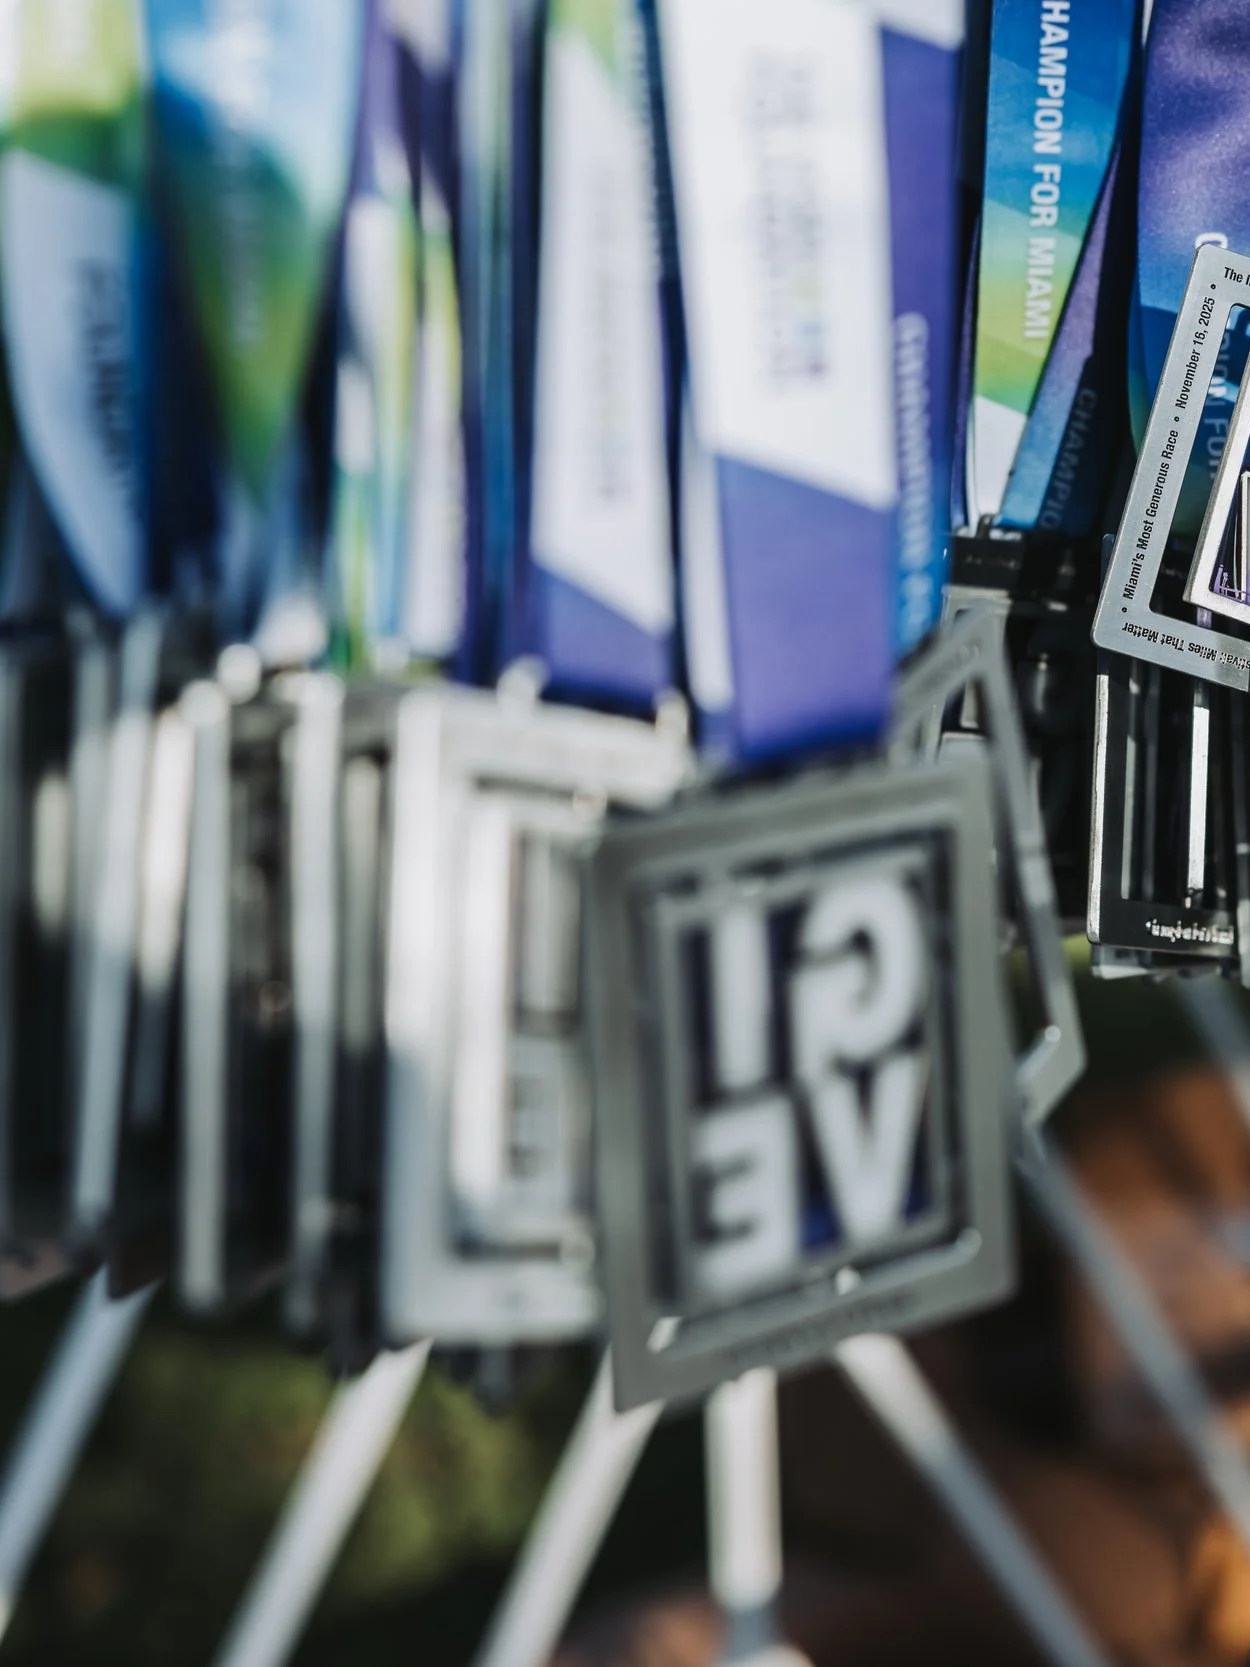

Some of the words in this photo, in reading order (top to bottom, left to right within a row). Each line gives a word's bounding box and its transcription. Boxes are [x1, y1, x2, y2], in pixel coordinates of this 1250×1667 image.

[1030, 165, 1061, 227] FOR
[1023, 237, 1056, 338] MIAMI
[1224, 266, 1244, 283] The
[1198, 297, 1216, 327] 2025
[1193, 329, 1208, 347] 16,
[1175, 347, 1201, 409] November
[1161, 429, 1179, 460] Race
[1146, 461, 1170, 518] Generous
[1136, 519, 1154, 551] Most
[1122, 551, 1145, 601] Miami's
[1121, 622, 1160, 644] Matter
[1160, 633, 1185, 652] That
[1187, 642, 1218, 661] Miles
